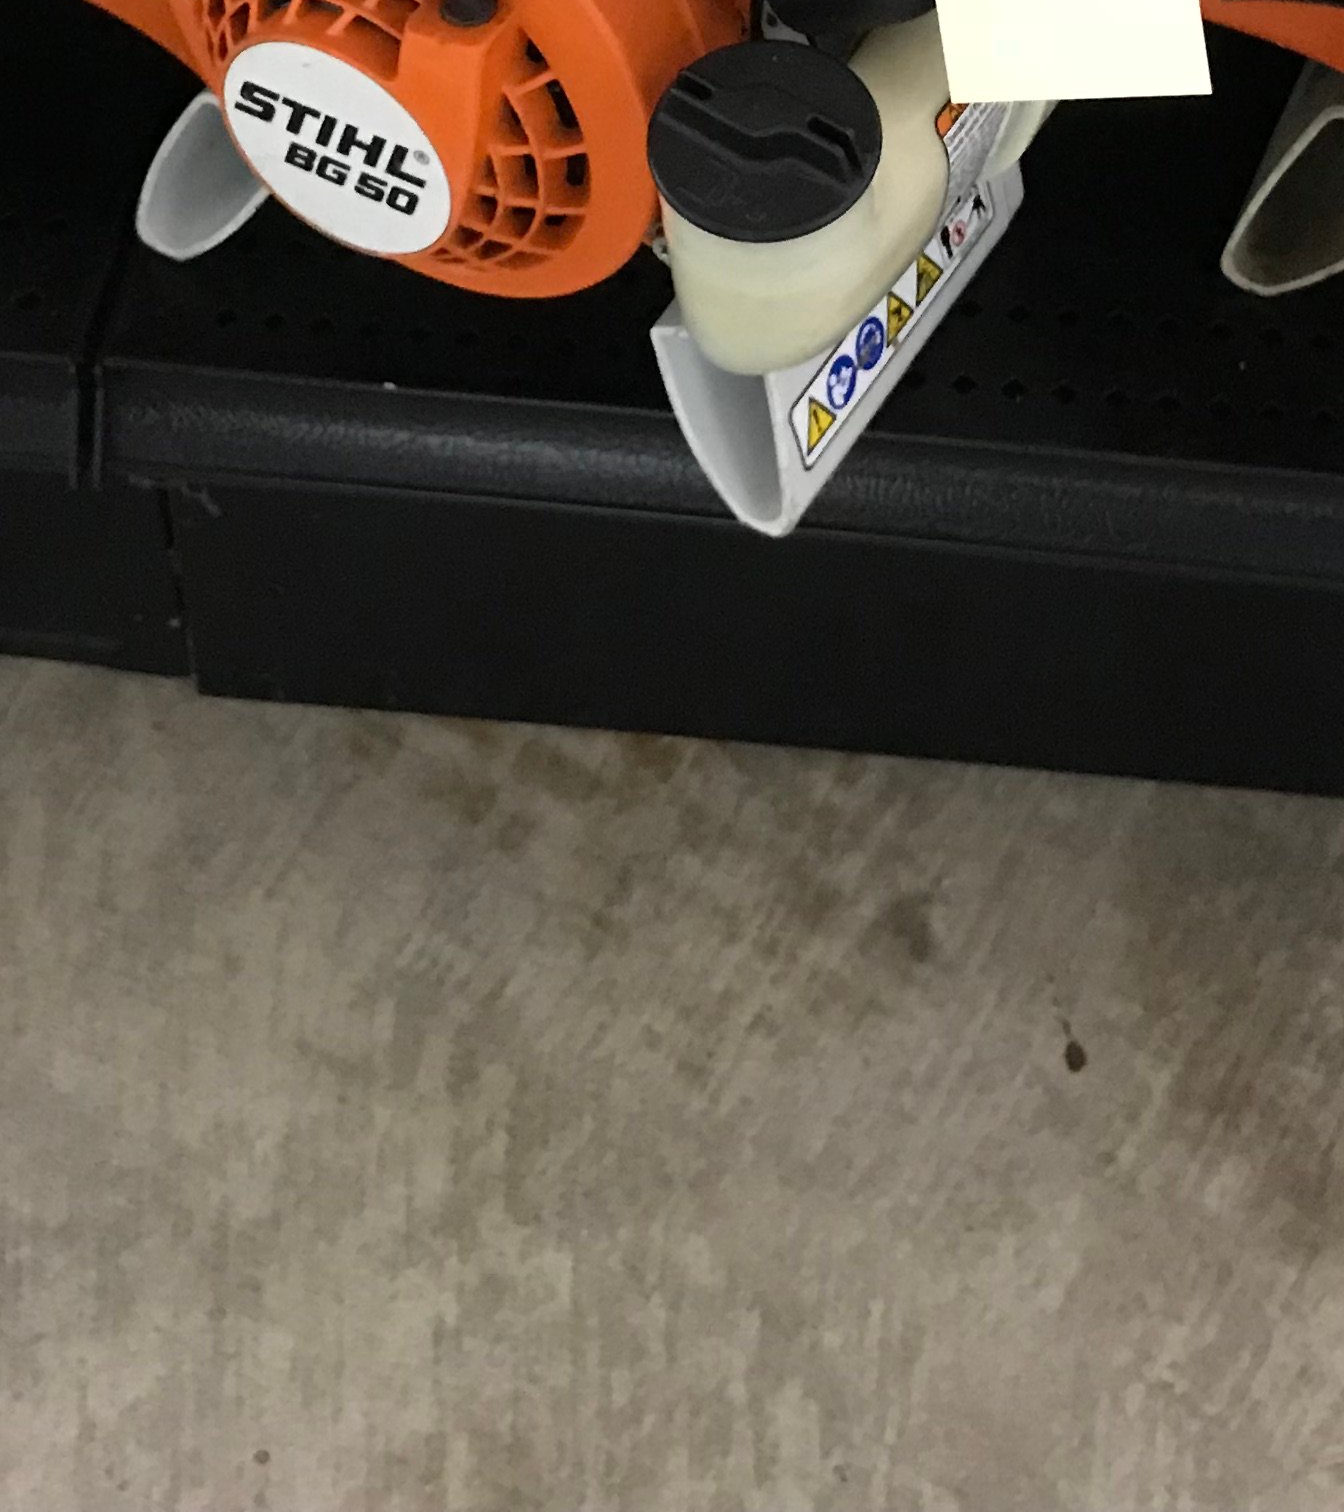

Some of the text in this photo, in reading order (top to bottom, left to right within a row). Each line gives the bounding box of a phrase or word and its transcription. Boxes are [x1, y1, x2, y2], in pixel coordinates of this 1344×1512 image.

[235, 81, 426, 189] STIHL
[284, 142, 419, 216] BG 50
